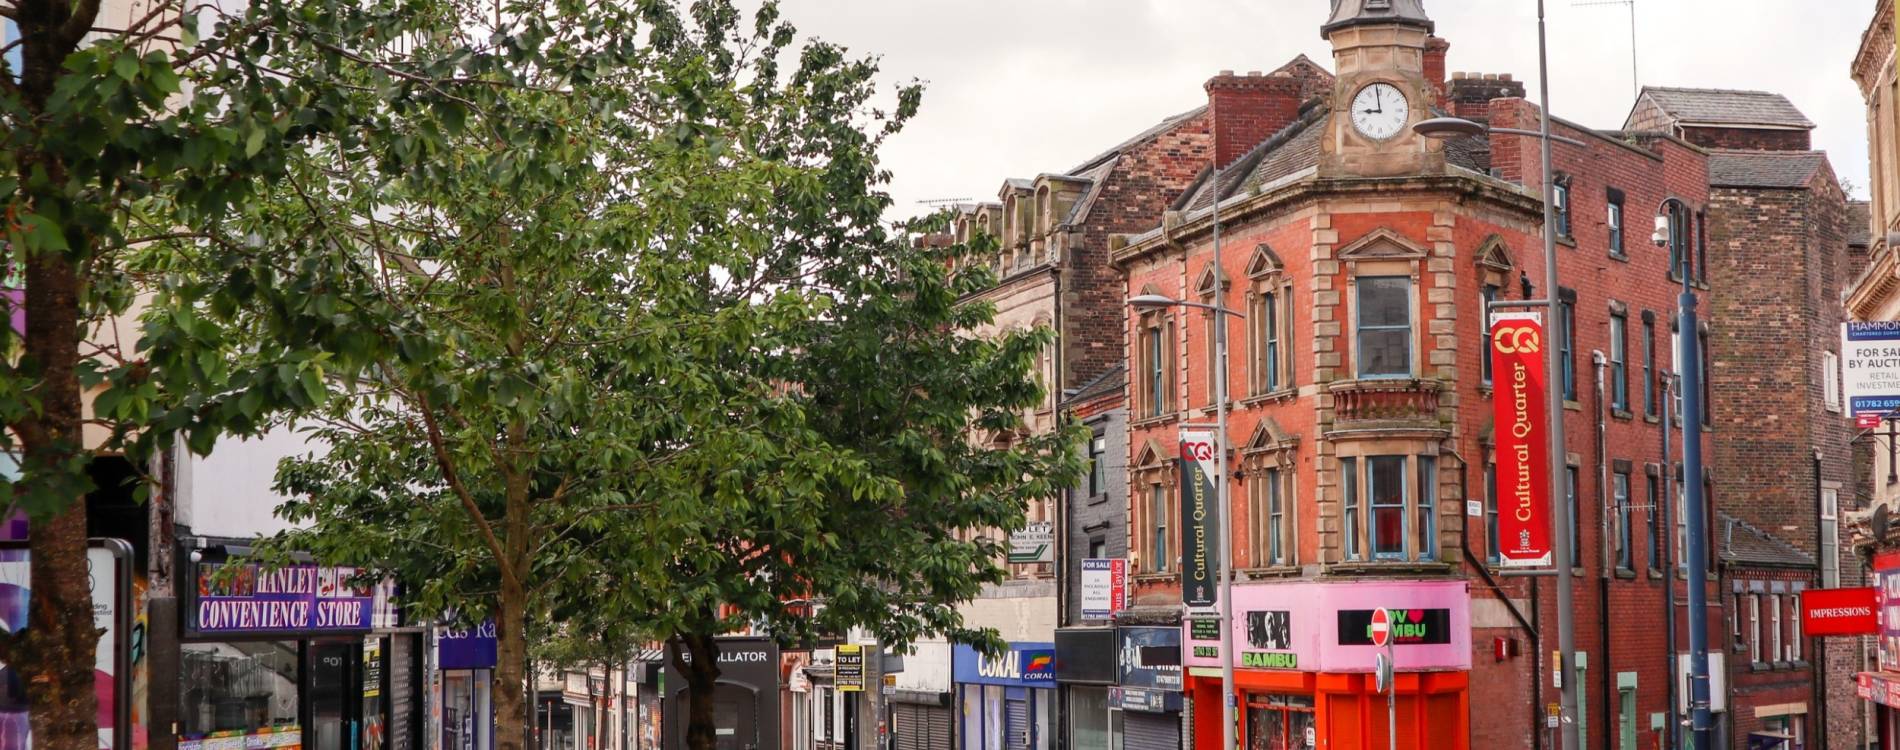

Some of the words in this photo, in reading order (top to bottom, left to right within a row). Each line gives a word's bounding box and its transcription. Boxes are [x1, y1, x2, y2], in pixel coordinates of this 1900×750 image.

[1849, 359, 1864, 369] BY
[1856, 347, 1880, 358] FOR
[1870, 372, 1899, 380] RETAIL
[1512, 362, 1532, 439] Quarter
[1855, 400, 1882, 408] 01782
[1192, 467, 1207, 522] Quarter
[1513, 444, 1532, 522] Cultural
[1193, 523, 1207, 581] Cultural
[256, 567, 315, 594] HANLEY
[1112, 561, 1125, 591] Taylor
[199, 600, 309, 629] CONVENIENCE
[316, 601, 361, 627] STORE
[1810, 606, 1871, 618] IMPRESSIONS
[977, 650, 1020, 678] CORAL
[1243, 652, 1297, 668] BAMBU
